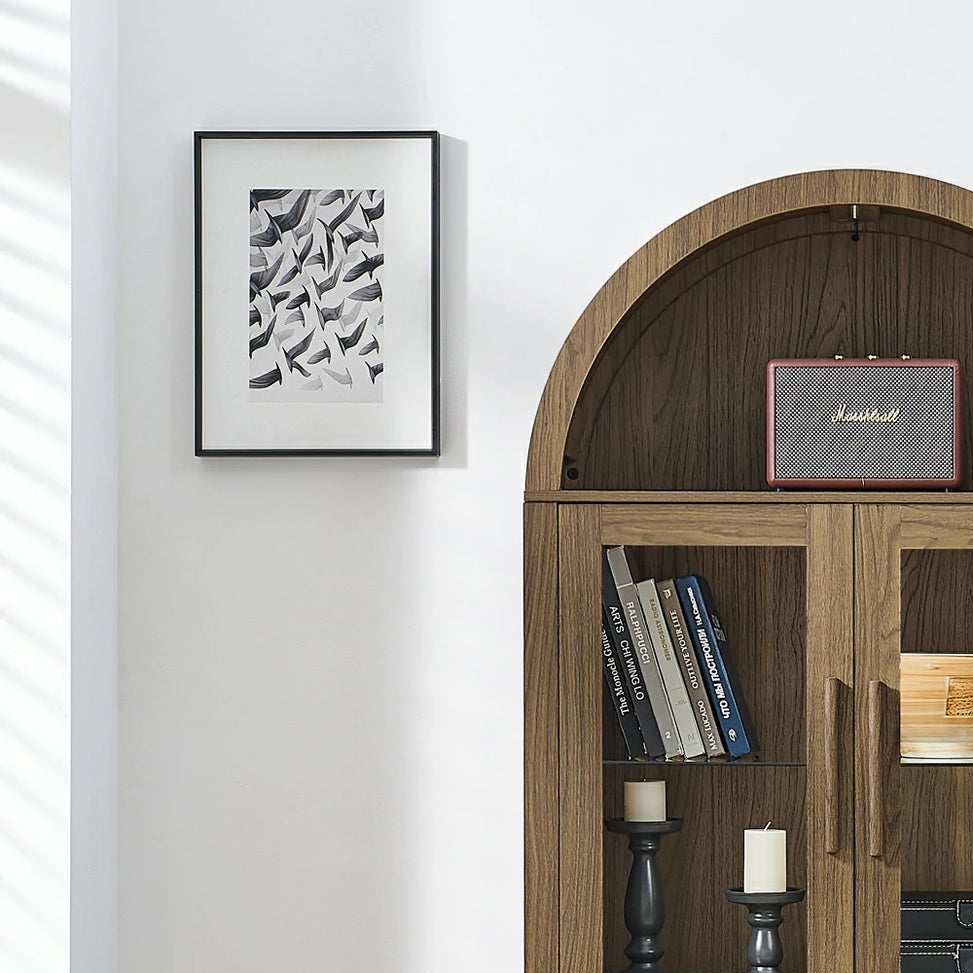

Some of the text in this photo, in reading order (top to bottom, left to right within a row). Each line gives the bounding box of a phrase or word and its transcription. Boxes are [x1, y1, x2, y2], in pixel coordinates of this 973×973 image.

[609, 607, 644, 700] ARTS CHI WING LO
[650, 599, 671, 660] RADIO ASTRONOMER
[670, 610, 698, 688] OUTLIVE YOUR LIFE
[607, 657, 624, 696] Monocle
[697, 629, 720, 681] ПОСТРОИЛИ
[619, 697, 629, 715] The
[714, 683, 725, 698] МЫ
[719, 700, 730, 718] ЧТО
[698, 700, 717, 750] MAX LUCADO
